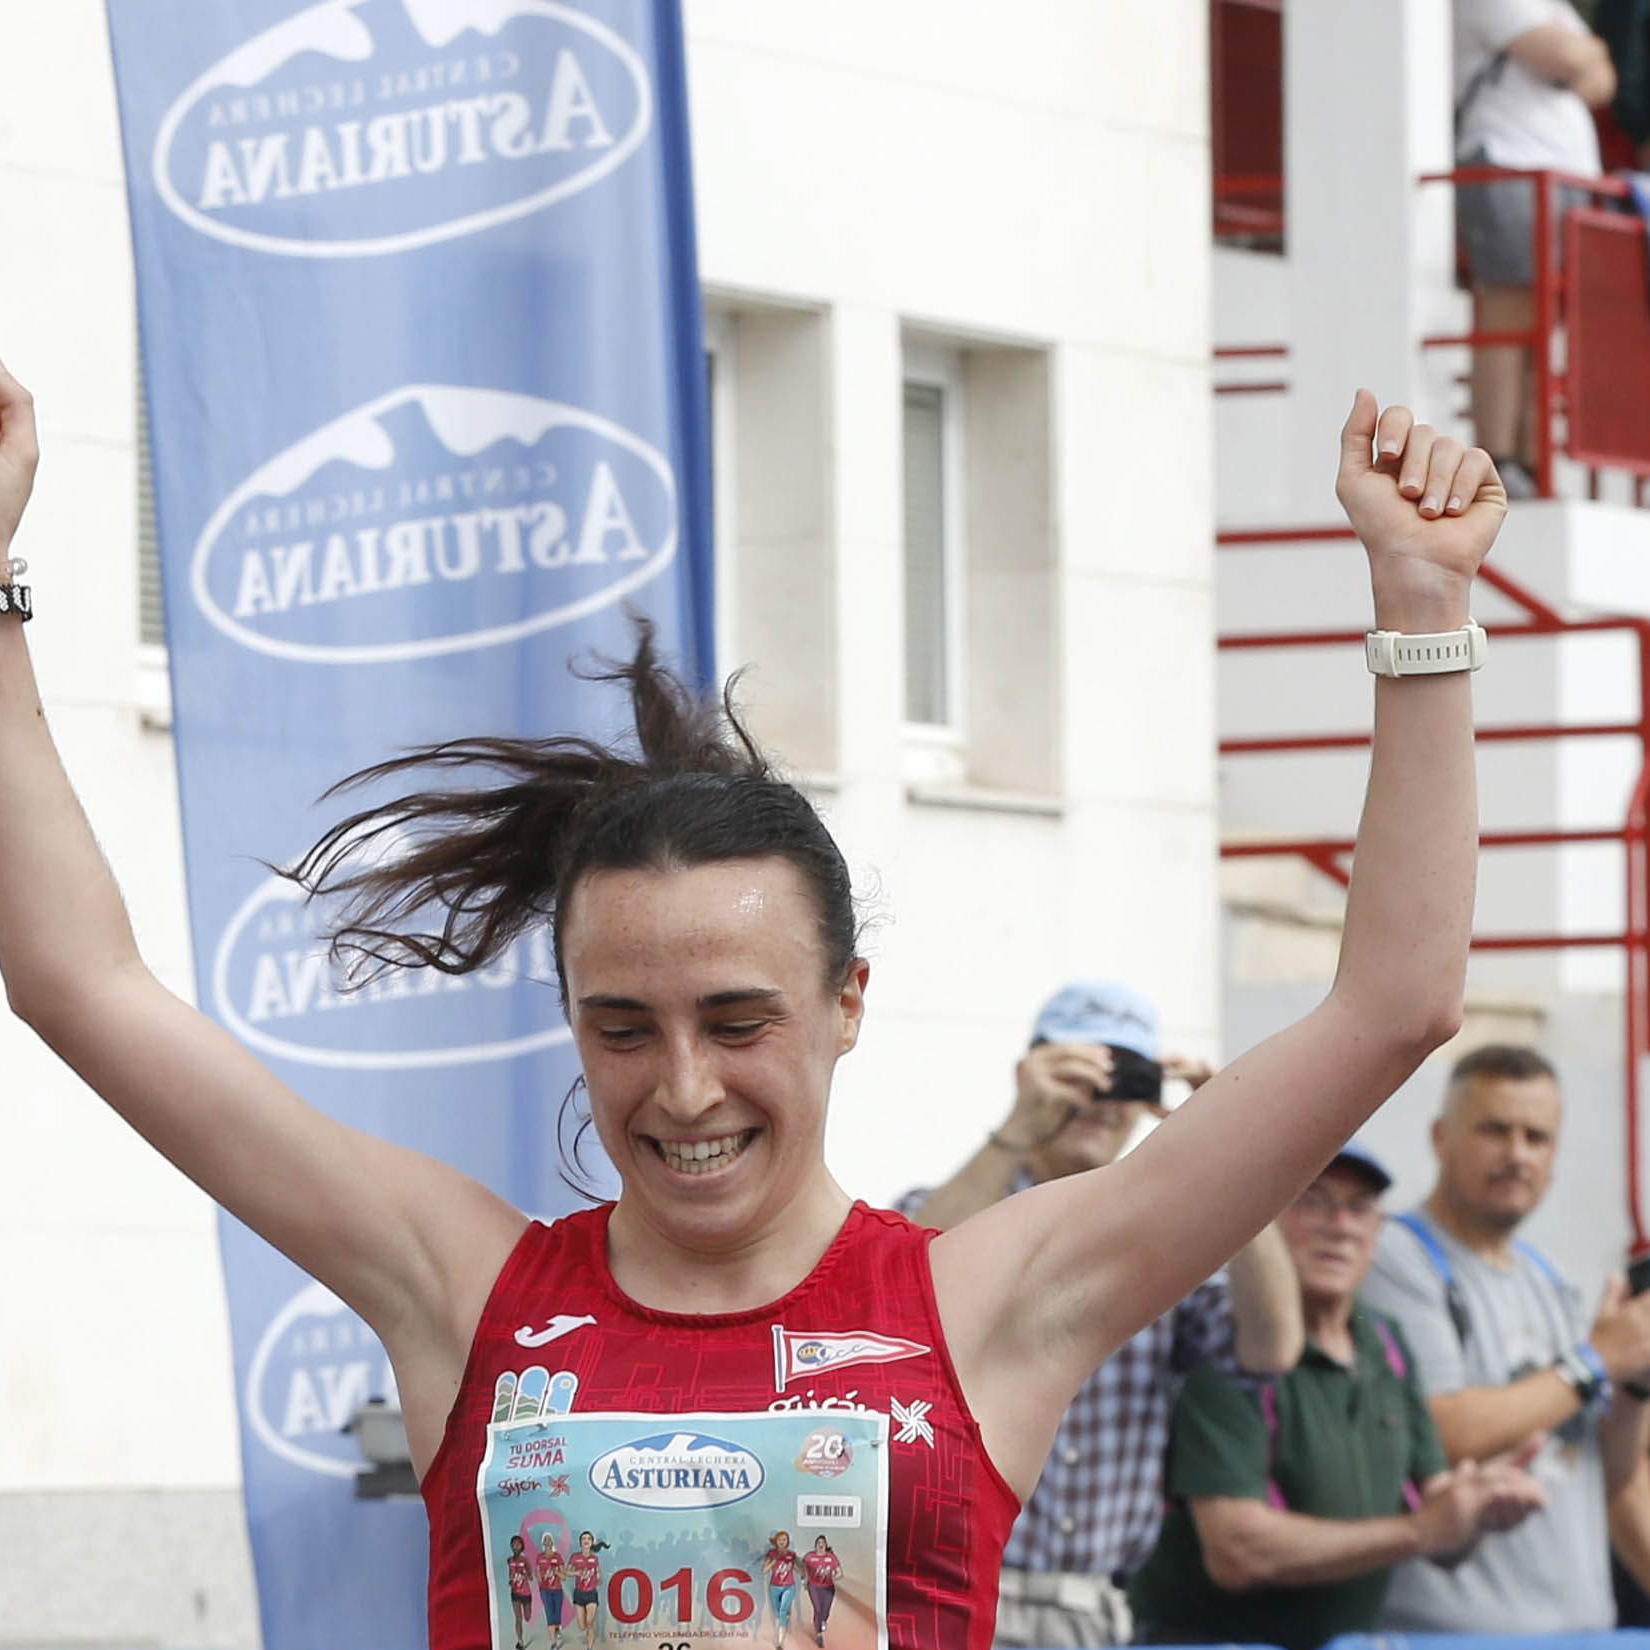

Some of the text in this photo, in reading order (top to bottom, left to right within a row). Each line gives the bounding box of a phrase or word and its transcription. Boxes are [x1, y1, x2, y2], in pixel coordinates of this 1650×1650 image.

[510, 1436, 568, 1455] TU DORSAL
[806, 1433, 845, 1460] 20
[506, 1448, 564, 1469] SUMA
[629, 1456, 684, 1465] CENTRAL
[602, 1457, 752, 1490] ASTURIANA
[606, 1567, 755, 1624] 016
